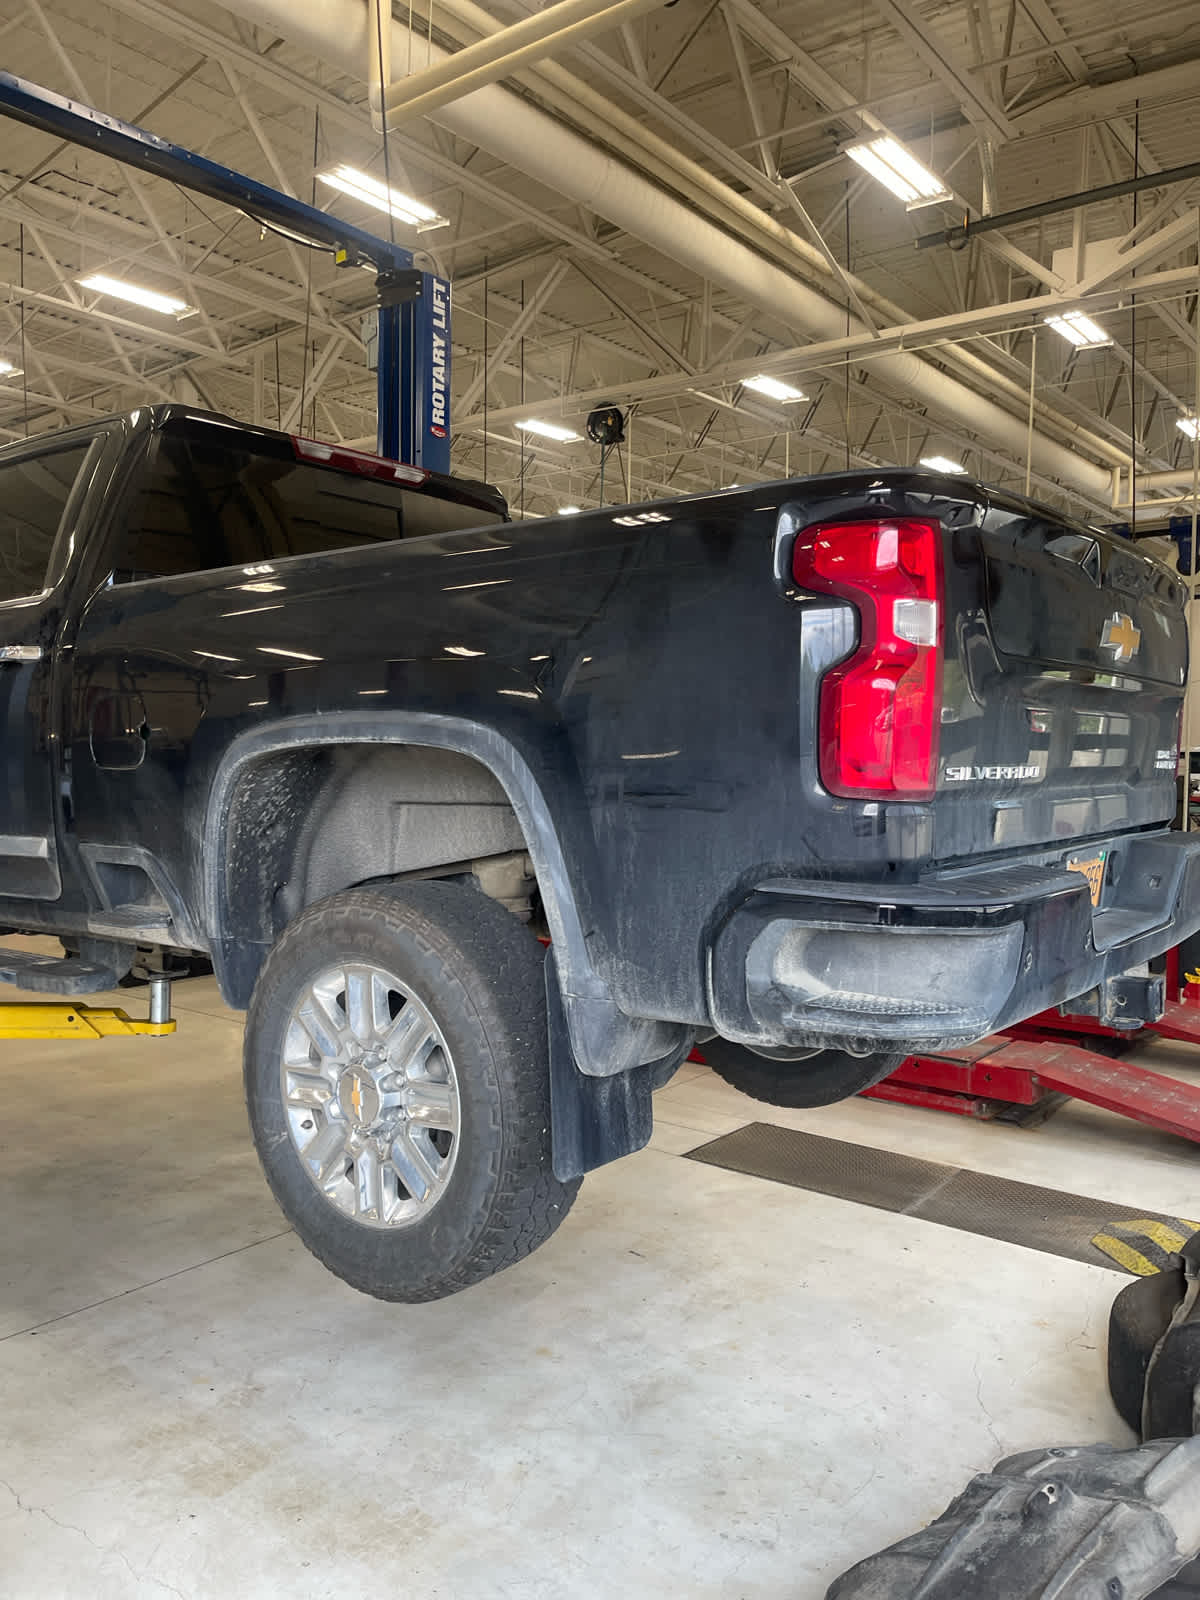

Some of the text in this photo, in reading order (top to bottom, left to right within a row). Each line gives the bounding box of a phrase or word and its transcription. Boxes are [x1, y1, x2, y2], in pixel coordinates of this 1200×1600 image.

[432, 278, 446, 330] LIFT
[431, 333, 446, 426] ROTARY
[945, 766, 1040, 781] SILVERADO
